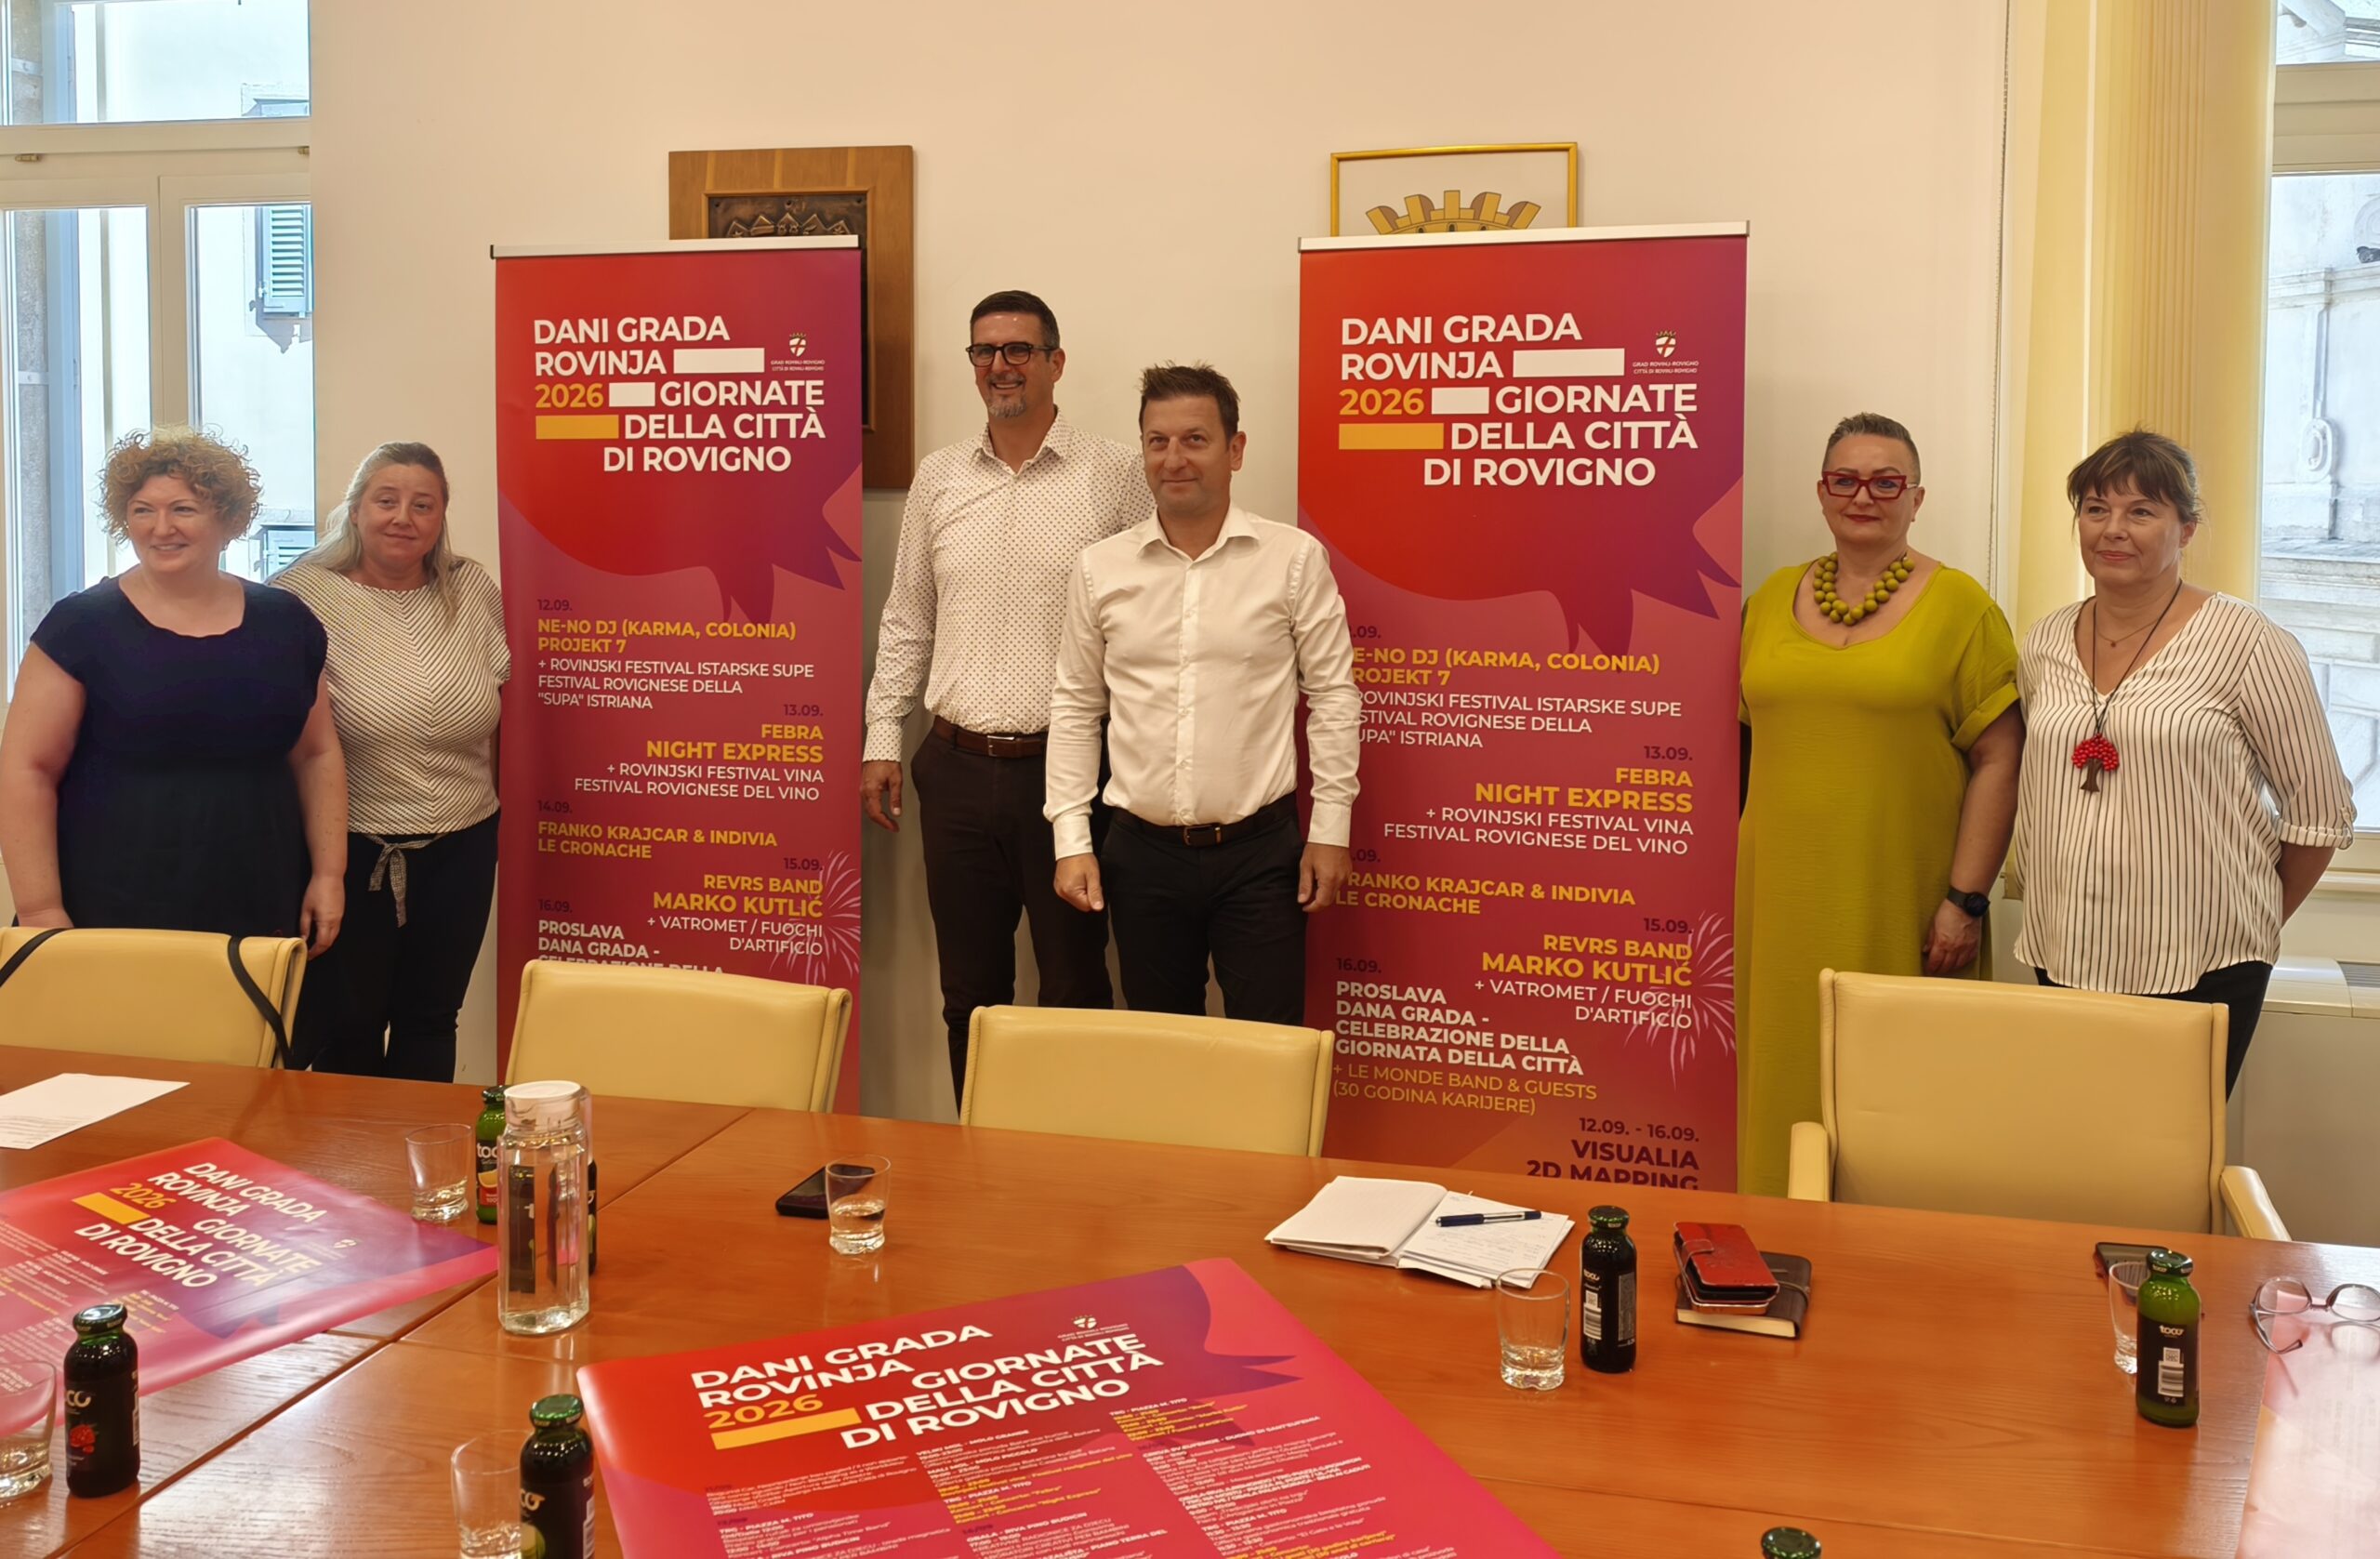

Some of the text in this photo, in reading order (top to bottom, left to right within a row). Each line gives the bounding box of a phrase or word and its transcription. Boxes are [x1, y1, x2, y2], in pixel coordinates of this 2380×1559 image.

[534, 315, 730, 344] DANI GRADA
[1342, 313, 1581, 345] DANI GRADA
[535, 349, 666, 377] ROVINJA
[1342, 351, 1503, 380] ROVINJA
[535, 380, 825, 408] 2026 GIORNATE
[1339, 384, 1698, 416] 2026 GIORNATE
[624, 407, 826, 439] DELLA CITTÀ
[1451, 415, 1699, 450] DELLA CITTÀ
[603, 447, 791, 472] DI ROVIGNO
[1423, 458, 1656, 486] DI ROVIGNO
[537, 599, 573, 611] 12.09.
[537, 619, 796, 640] NE-NO DJ (KARMA, COLONIA)
[537, 638, 627, 653] PROJEKT 7
[550, 659, 813, 678] ROVINJSKI FESTIVAL ISTARSKE SUPE
[1353, 648, 1659, 674] E-NO DJ (KARMA, COLONIA)
[538, 676, 743, 694] FESTIVAL ROVIGNESE DELLA
[1353, 667, 1450, 686] ROJEKT 7
[538, 693, 653, 709] "SUPA" ISTRIANA
[783, 705, 824, 717] 13.09.
[1449, 694, 1682, 717] FESTIVAL ISTARSKE SUPE
[761, 724, 824, 740] FEBRA
[1359, 710, 1592, 733] STIVAL ROVIGNESE DELLA
[1400, 731, 1483, 747] ISTRIANA
[647, 741, 824, 763] NIGHT EXPRESS
[1644, 746, 1693, 760] 13.09.
[619, 763, 824, 783] ROVINJSKI FESTIVAL VINA
[1616, 768, 1693, 786] FEBRA
[575, 779, 819, 800] FESTIVAL ROVIGNESE DEL VINO
[1475, 783, 1693, 813] NIGHT EXPRESS
[537, 800, 573, 813] 14.09.
[1441, 807, 1693, 835] ROVINJSKI FESTIVAL VINA
[538, 822, 777, 846] FRANKO KRAJCAR & INDIVIA
[1384, 824, 1687, 854] FESTIVAL ROVIGNESE DEL VINO
[538, 839, 652, 858] LE CRONACHE
[784, 858, 824, 870] 15.09.
[704, 875, 824, 894] REVRS BAND
[1348, 872, 1635, 905] RANKO KRAJCAR & INDIVIA
[538, 900, 573, 913] 16.09.
[654, 892, 824, 918] MARKO KUTLIĆ
[1336, 891, 1481, 915] LE CRONACHE
[538, 920, 625, 939] PROSLAVA
[659, 916, 822, 937] VATROMET FUOCHI
[1644, 918, 1692, 934] 15.09.
[538, 937, 649, 958] DANA GRADA
[730, 938, 822, 956] D'ARTIFICIO
[1543, 934, 1692, 960] REVRS BAND
[1337, 958, 1382, 973] 16.09.
[1482, 952, 1692, 986] MARKO KUTLIĆ
[1337, 982, 1447, 1004] PROSLAVA
[1490, 979, 1692, 1009] VATROMET FUOCHI
[1336, 1000, 1476, 1026] DANA GRADA
[1576, 1006, 1692, 1028] D'ARTIFICIO
[1336, 1020, 1569, 1054] CELEBRAZIONE DELLA
[1336, 1039, 1583, 1076] GIORNATA DELLA CITTÀ
[1348, 1064, 1597, 1100] LE MONDE BAND & GUESTS
[1333, 1079, 1536, 1116] (30 GODINA KARIJERE)
[1579, 1117, 1699, 1142] 12.09. 16.09.
[1571, 1139, 1699, 1170] VISUALIA
[1527, 1159, 1561, 1180] 2D
[148, 1172, 250, 1217] ROVINJA
[183, 1162, 326, 1223] DANI GRADA
[109, 1182, 177, 1209] 2026
[192, 1218, 323, 1275] GIORNATE
[74, 1222, 121, 1240] DI
[99, 1235, 218, 1288] ROVIGNO
[127, 1218, 284, 1287] DELLA CITTÀ
[691, 1325, 993, 1389] DANI GRADA
[698, 1359, 916, 1408] ROVINJA
[703, 1333, 1146, 1429] 2026 GIORNATE
[865, 1350, 1165, 1421] DELLA CITTÀ
[840, 1427, 897, 1449] DI
[910, 1378, 1130, 1435] ROVIGNO
